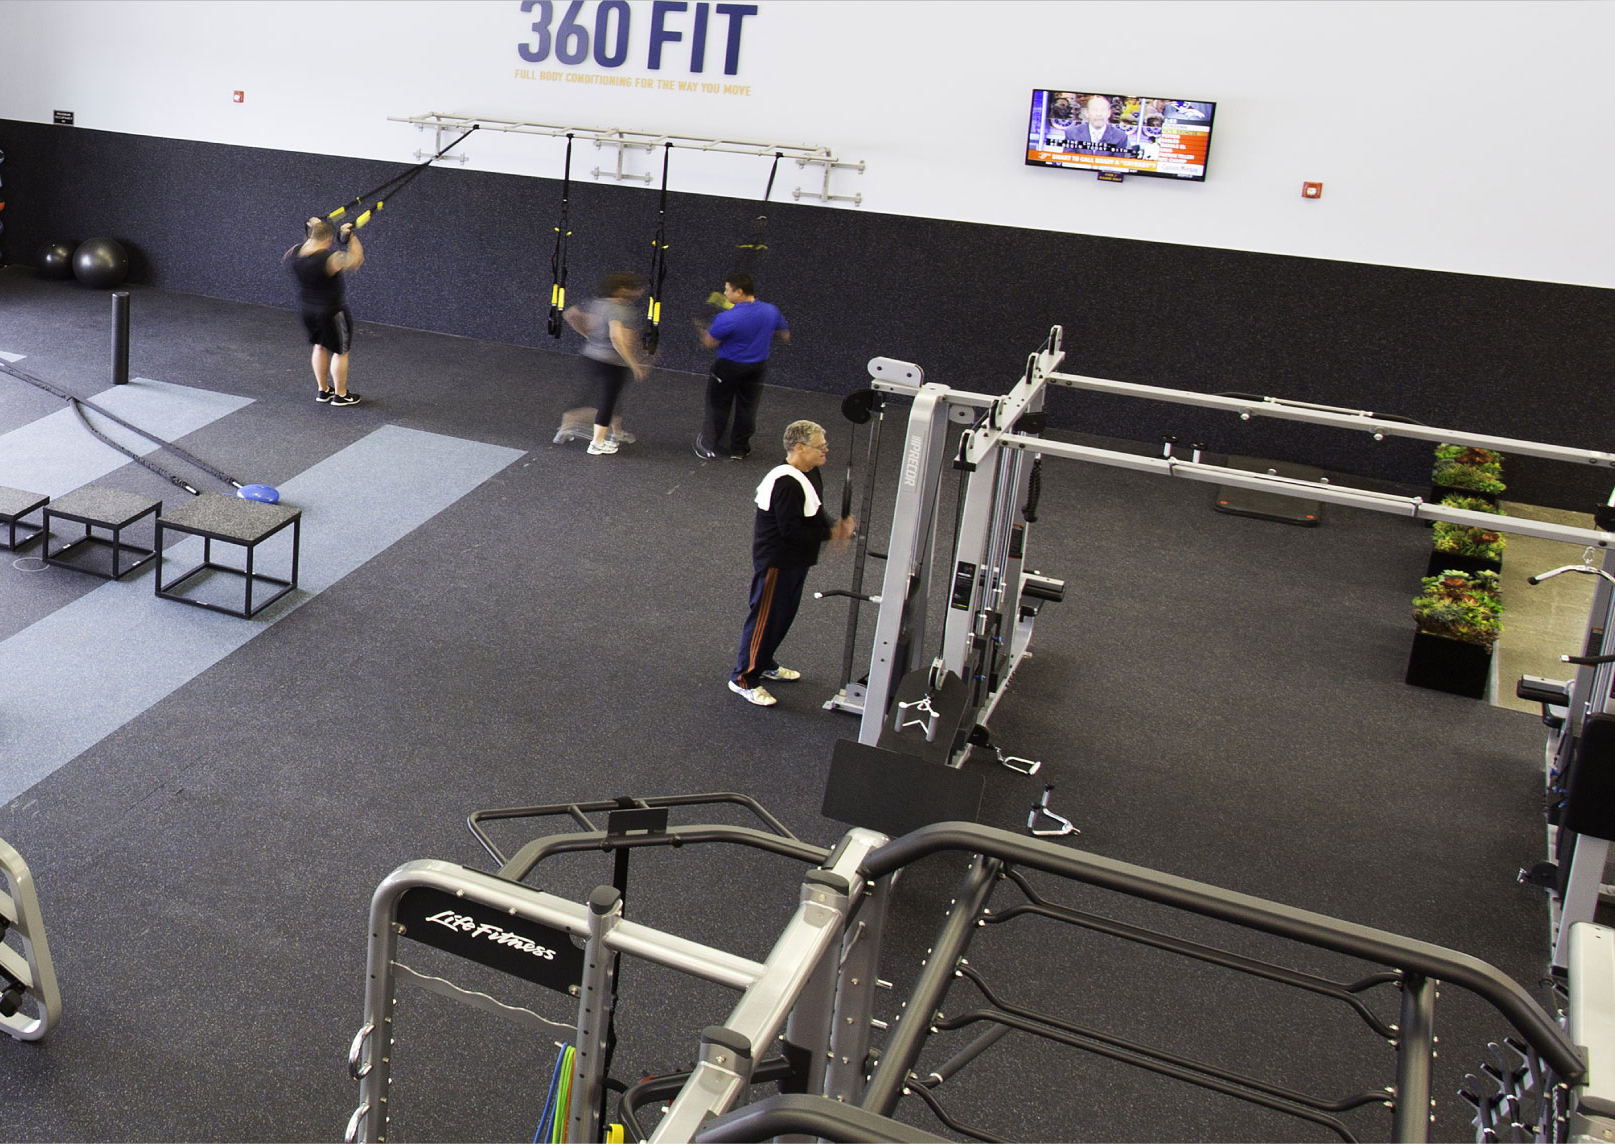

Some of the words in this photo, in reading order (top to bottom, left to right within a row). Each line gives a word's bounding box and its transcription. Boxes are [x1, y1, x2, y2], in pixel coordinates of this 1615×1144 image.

[517, 0, 631, 68] 360
[648, 1, 758, 76] FIT
[515, 69, 537, 80] FULL
[540, 71, 563, 82] BODY
[565, 72, 632, 87] CONDITIONING
[635, 78, 653, 89] FOR
[658, 79, 675, 91] THE
[678, 81, 698, 92] WAY
[701, 83, 720, 94] YOU
[723, 85, 752, 97] MOVE
[904, 442, 922, 487] PRECOR
[425, 910, 475, 932] Life
[471, 923, 557, 960] Fitness
